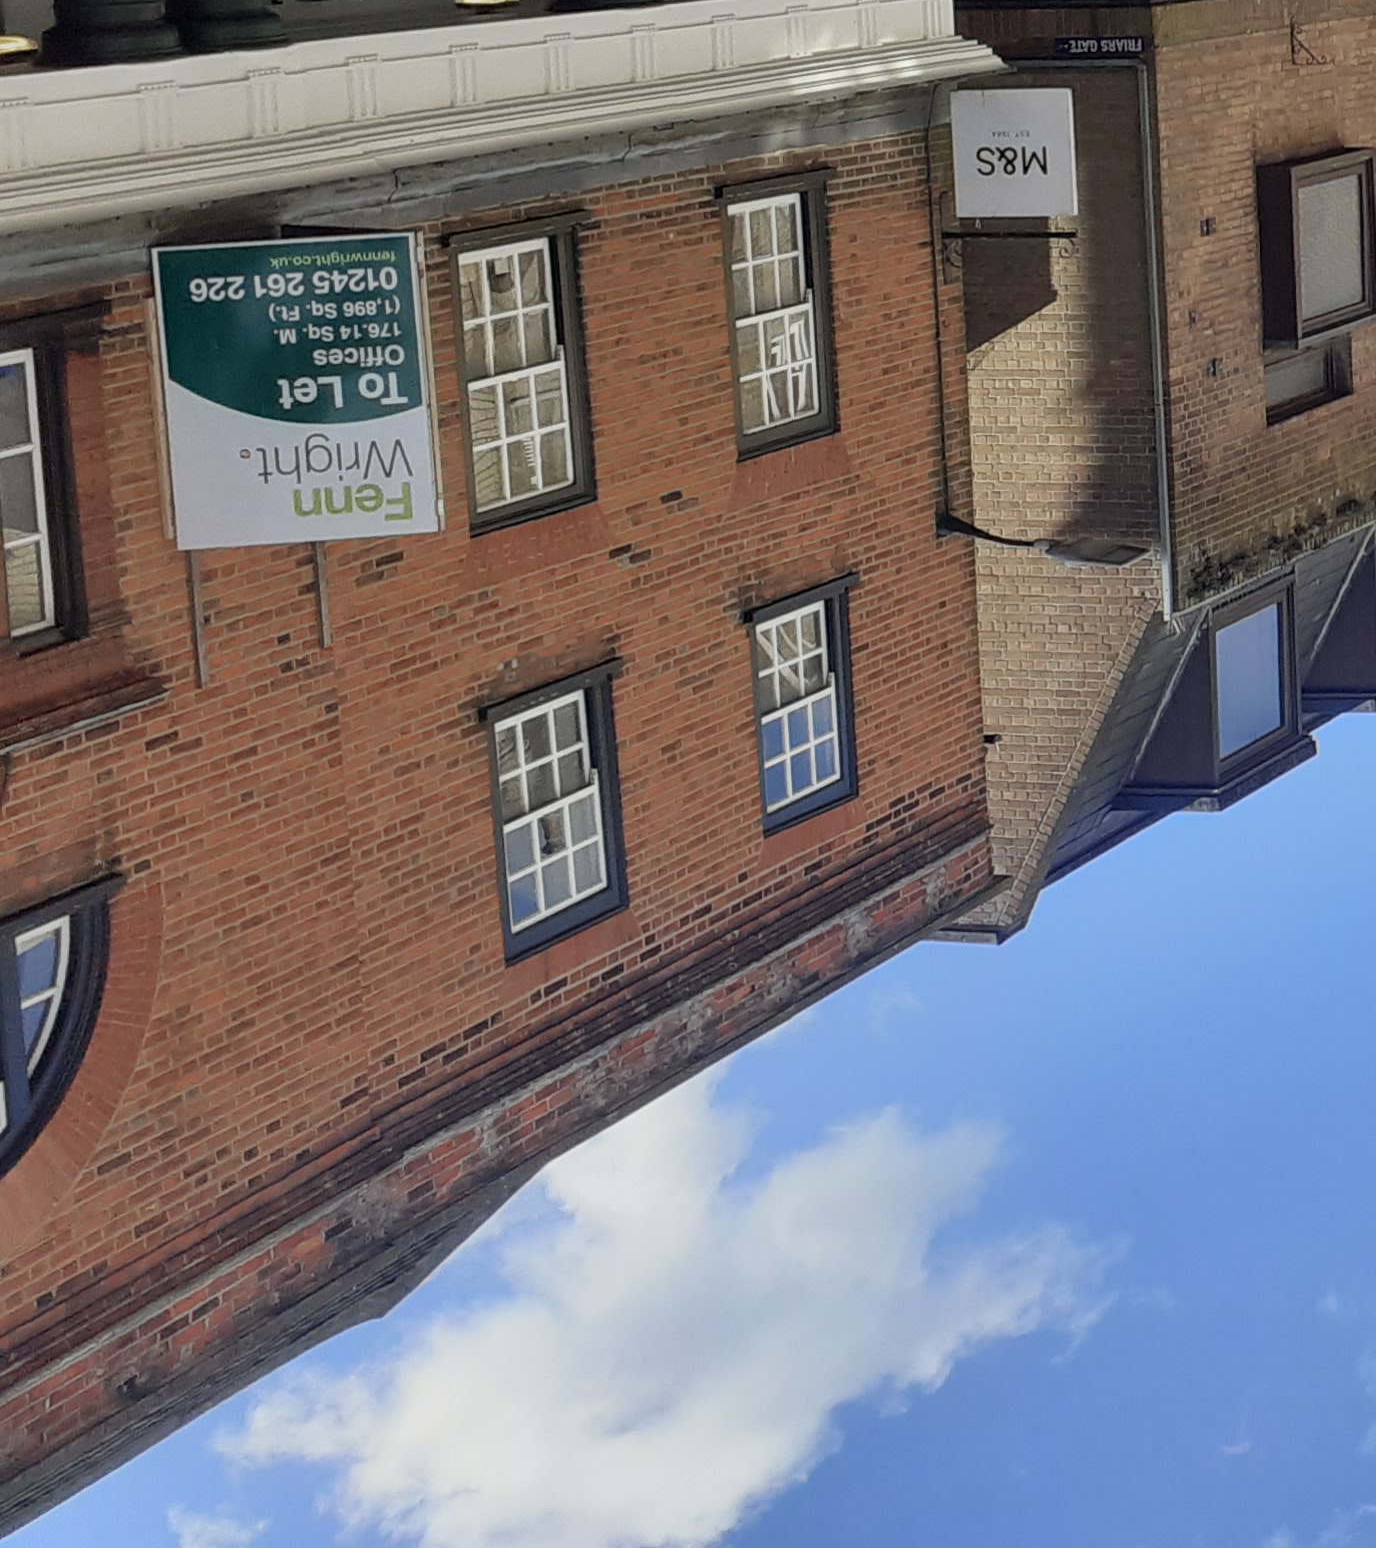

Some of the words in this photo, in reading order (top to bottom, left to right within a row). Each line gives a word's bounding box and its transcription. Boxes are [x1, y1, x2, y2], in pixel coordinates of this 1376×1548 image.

[1068, 40, 1098, 53] GATE
[1100, 38, 1142, 52] FRIARS
[976, 146, 1047, 176] M&S
[269, 249, 397, 269] fennwright.co.uk
[189, 275, 245, 302] 226
[253, 271, 304, 298] 261
[312, 265, 398, 294] 01245
[268, 302, 300, 322] Ft.)
[306, 300, 338, 319] Sq.
[343, 295, 401, 317] (1,896
[273, 328, 296, 344] M.
[302, 323, 334, 342] Sq.
[339, 321, 402, 339] 176.14
[312, 344, 405, 366] Offices
[277, 375, 344, 410] Let
[358, 371, 408, 405] To
[292, 481, 414, 521] Fenn
